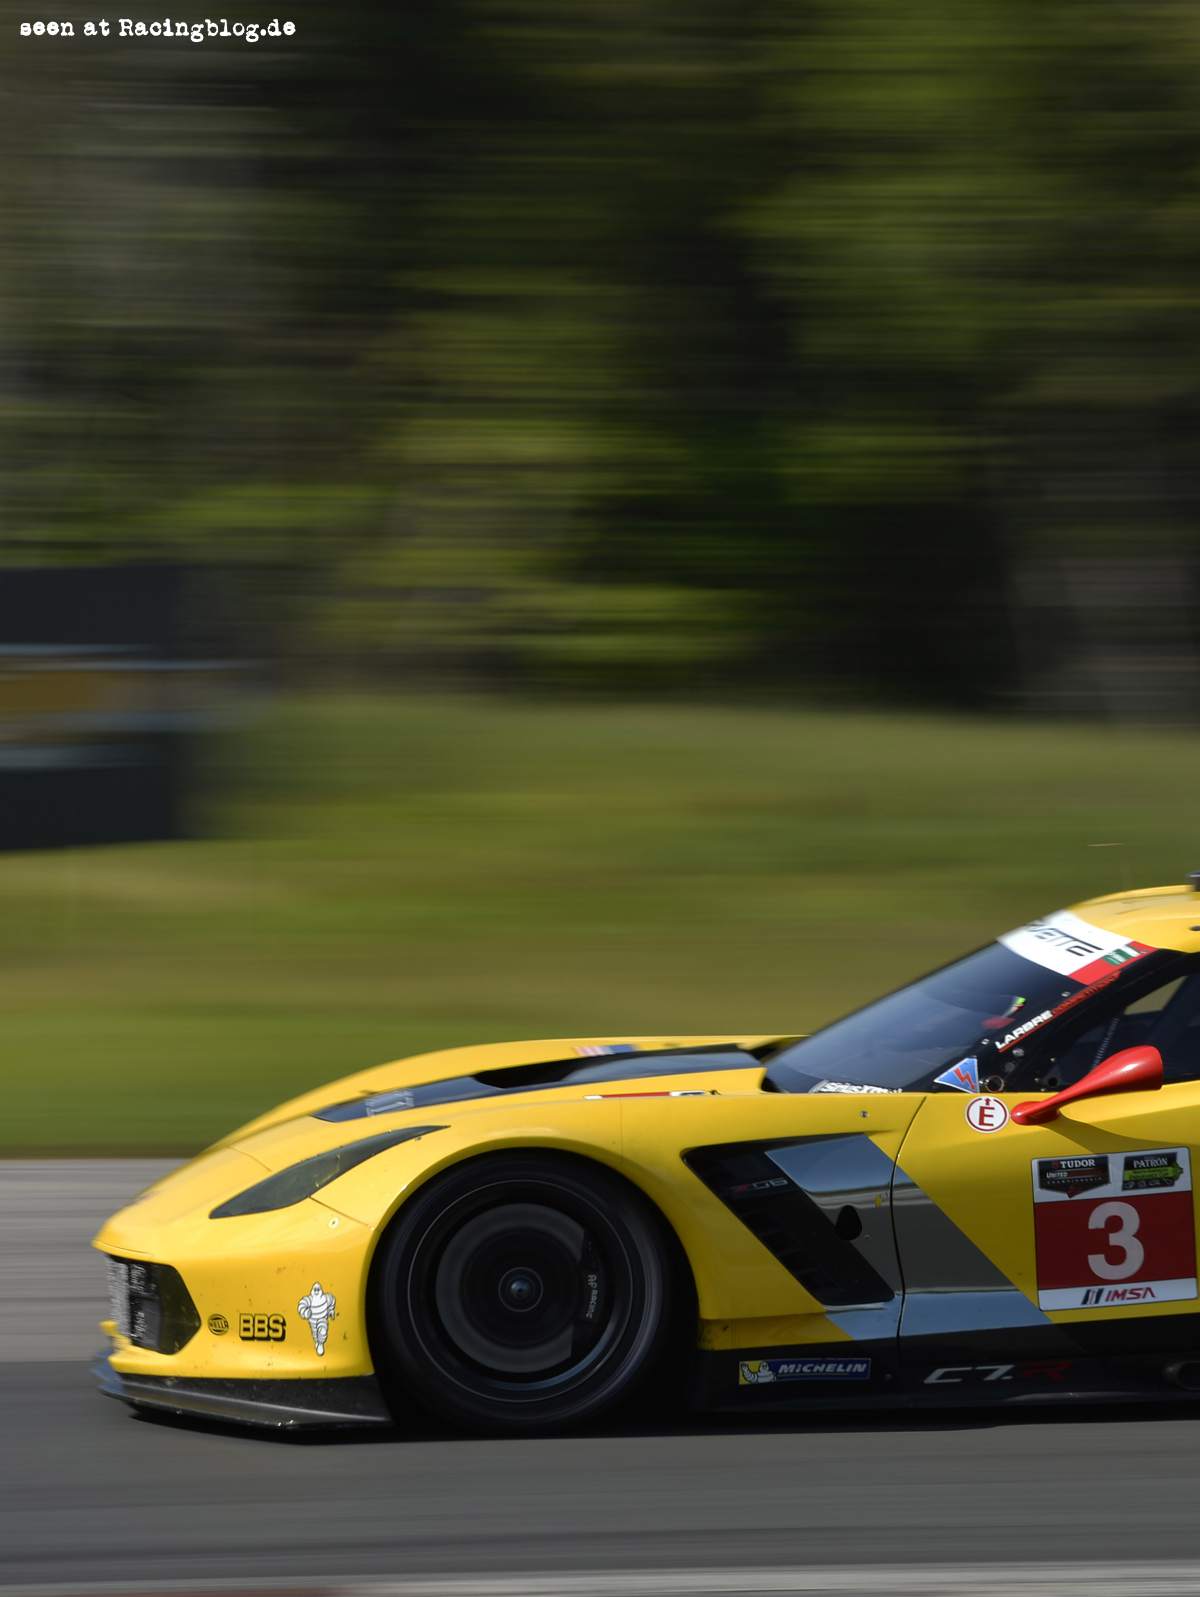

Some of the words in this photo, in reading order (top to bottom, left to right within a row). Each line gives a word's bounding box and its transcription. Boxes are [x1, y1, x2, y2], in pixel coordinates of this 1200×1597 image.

[994, 1009, 1053, 1050] LARBRE
[978, 1105, 995, 1127] E
[1060, 1158, 1096, 1169] TUDOR
[1087, 1201, 1145, 1281] 3
[1104, 1286, 1157, 1303] IMSA
[239, 1313, 287, 1342] BBS
[778, 1362, 868, 1374] MICHELIN
